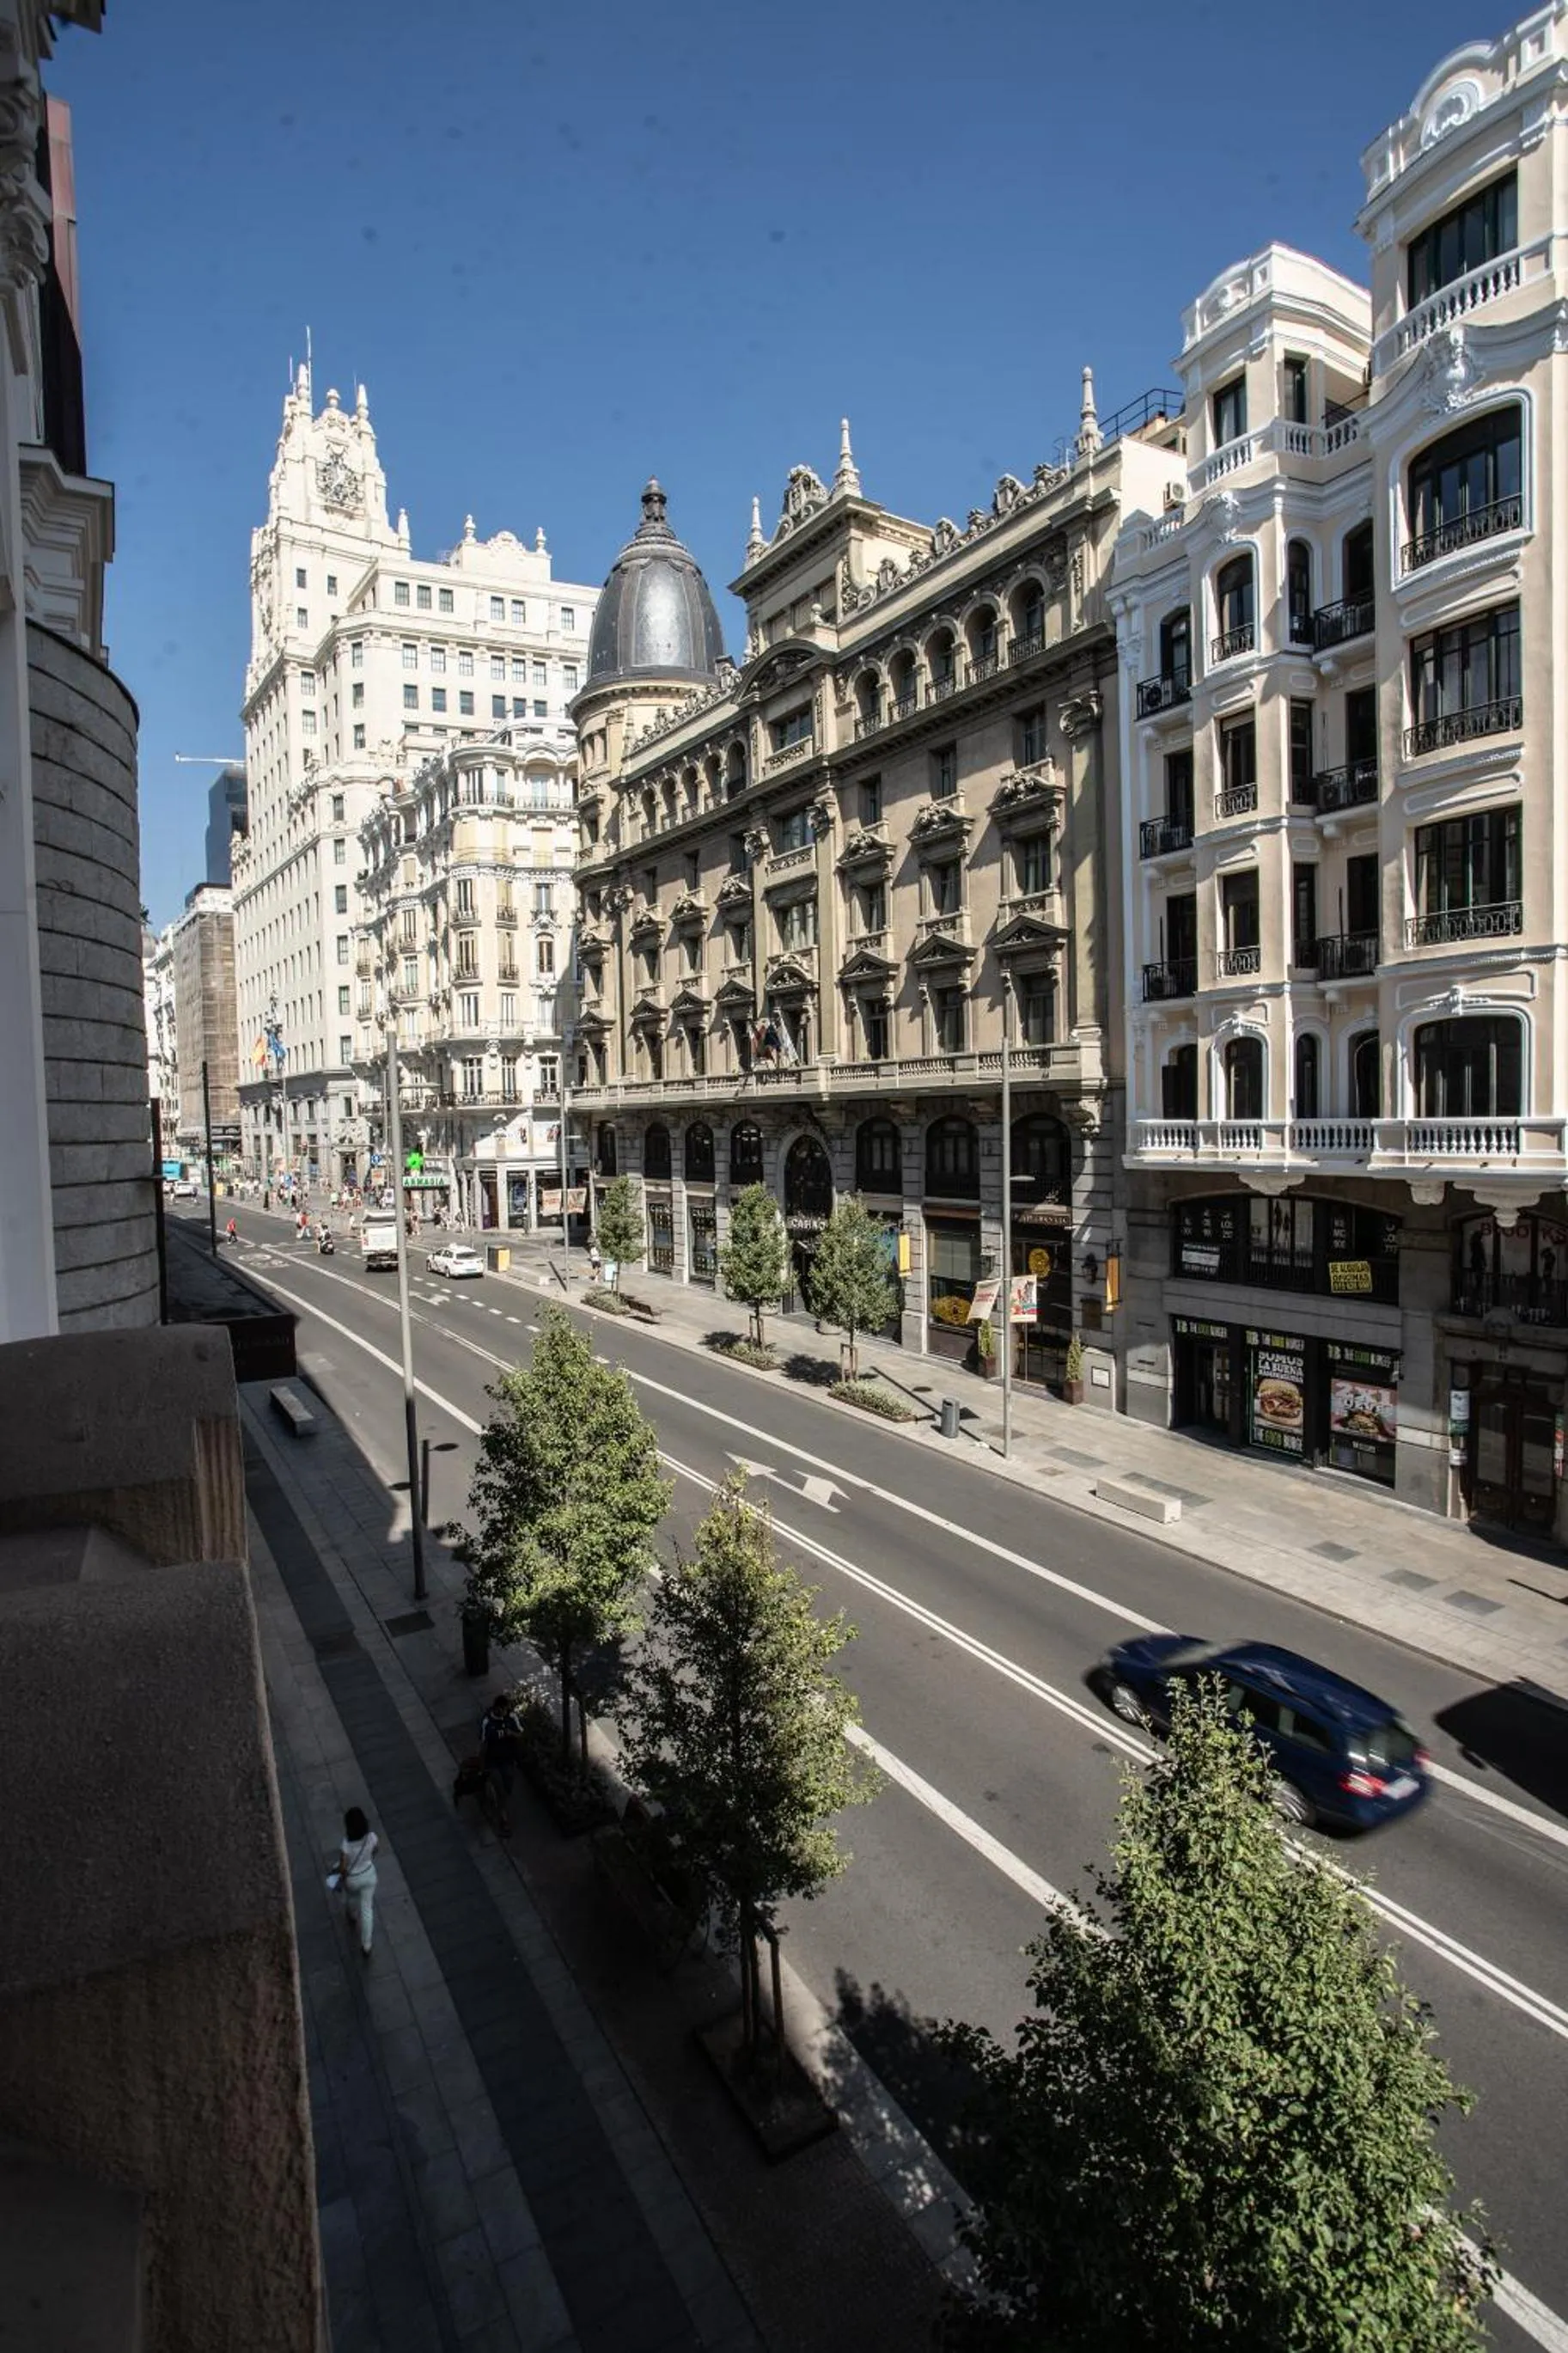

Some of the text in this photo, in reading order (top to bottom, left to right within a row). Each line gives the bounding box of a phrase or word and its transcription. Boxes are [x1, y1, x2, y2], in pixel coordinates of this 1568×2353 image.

[404, 1177, 445, 1186] ARMACIA
[1258, 1360, 1304, 1378] LA BUENA
